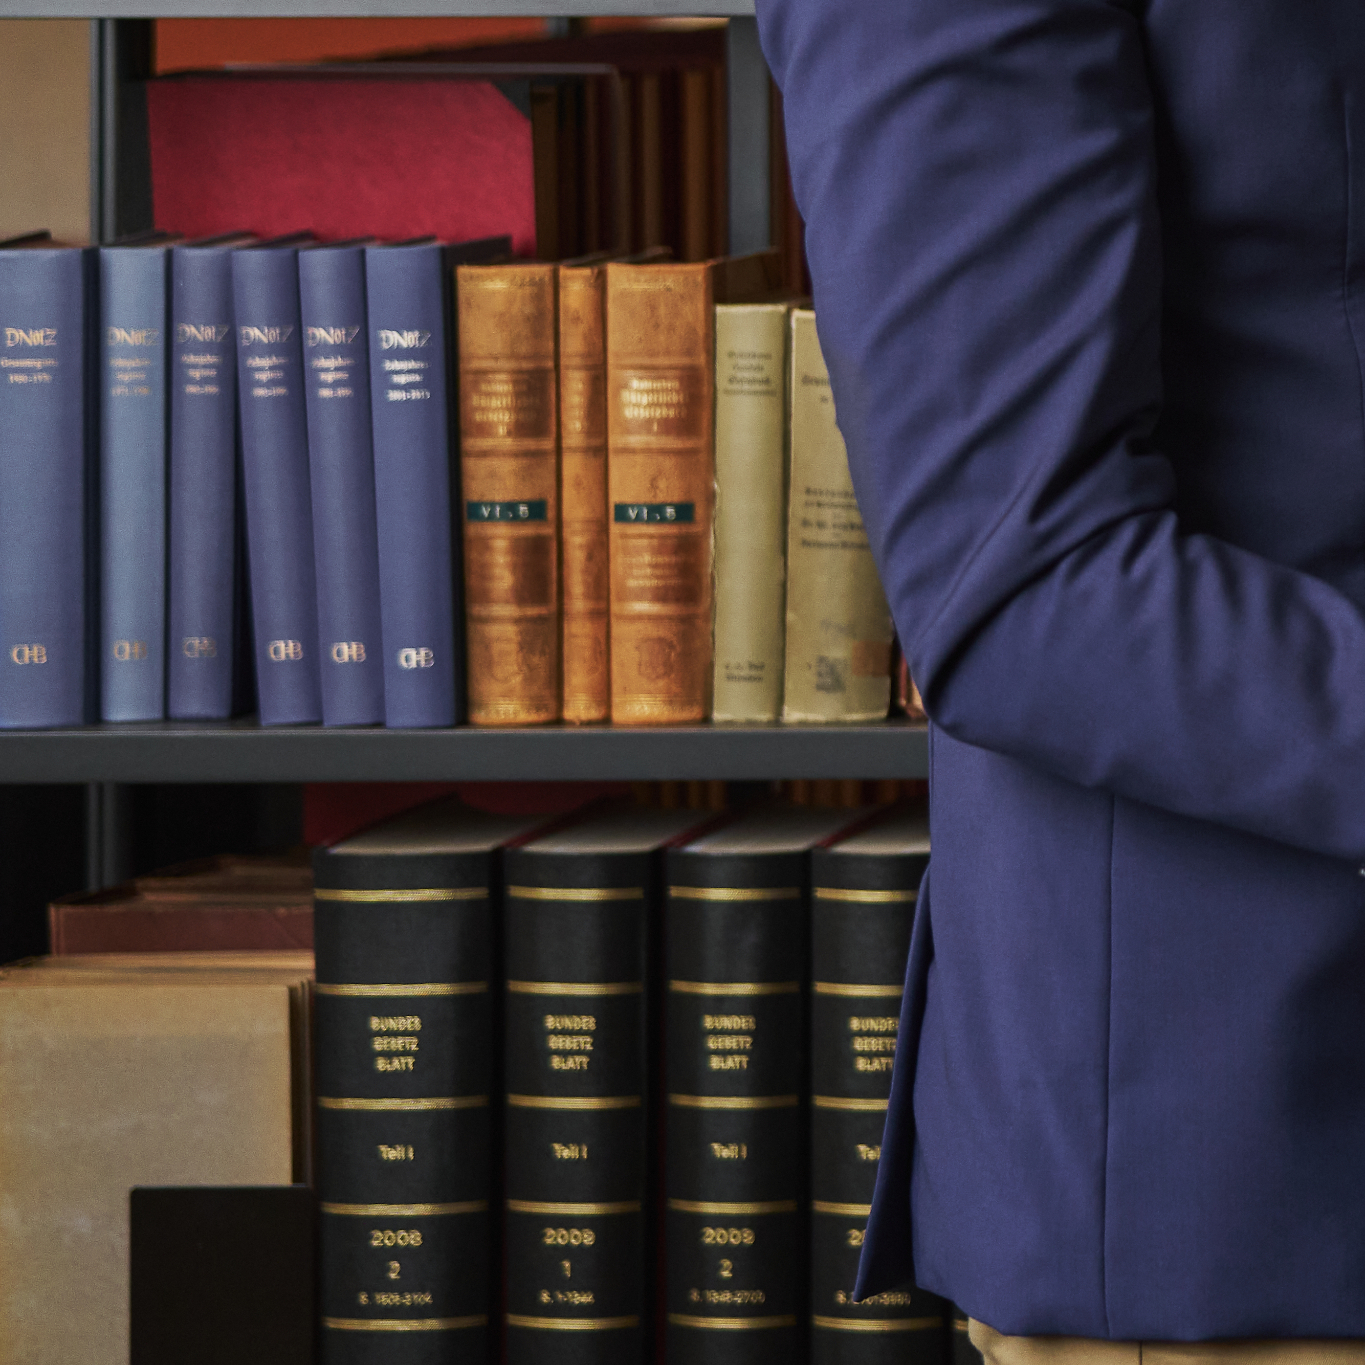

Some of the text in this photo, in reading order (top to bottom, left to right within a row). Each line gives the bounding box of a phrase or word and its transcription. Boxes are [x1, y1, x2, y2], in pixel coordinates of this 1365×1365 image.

[388, 1261, 400, 1280] 2
[561, 1260, 571, 1277] 1
[719, 1259, 732, 1279] 2
